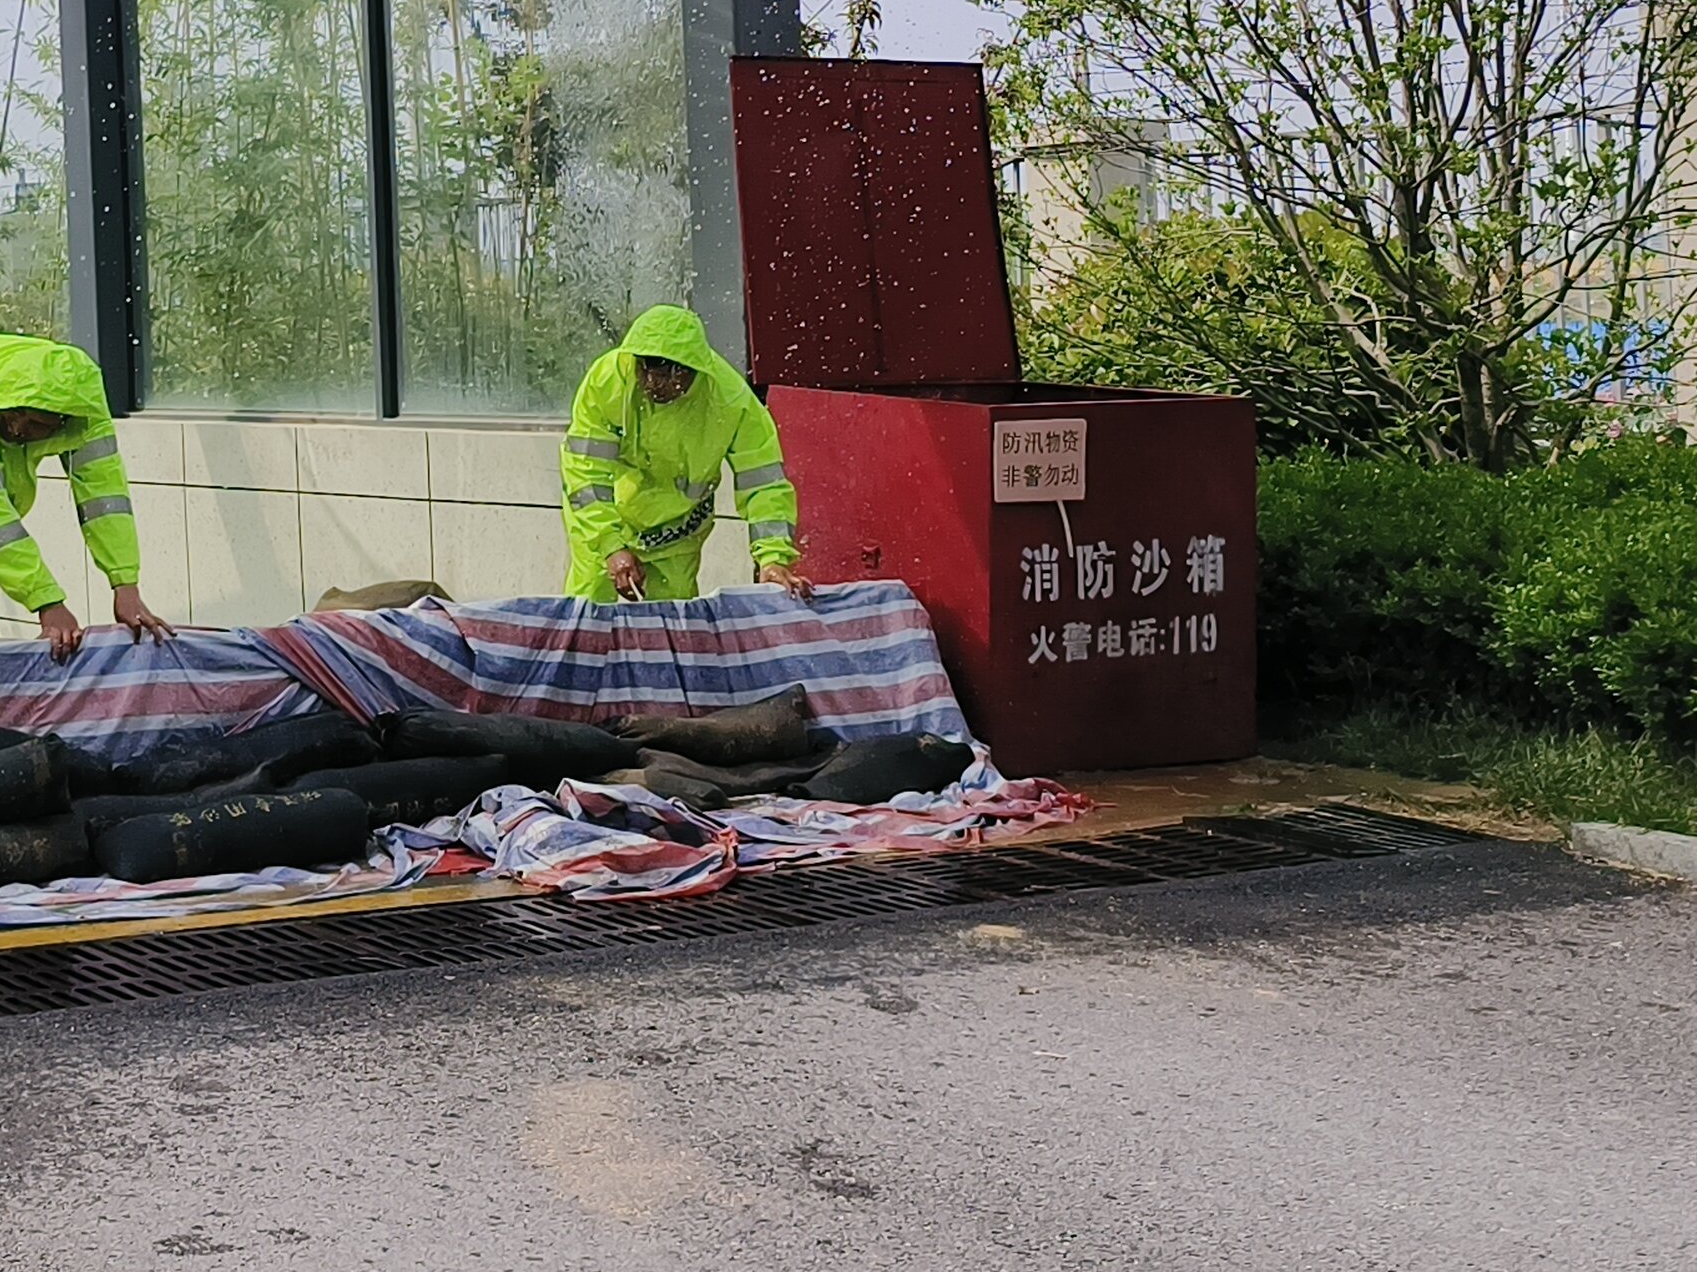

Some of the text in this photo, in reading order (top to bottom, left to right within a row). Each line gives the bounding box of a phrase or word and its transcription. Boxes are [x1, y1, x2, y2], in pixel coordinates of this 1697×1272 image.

[1002, 429, 1079, 455] 防汛物资
[1002, 462, 1079, 488] 非警勿动
[1020, 534, 1226, 602] 消防沙箱
